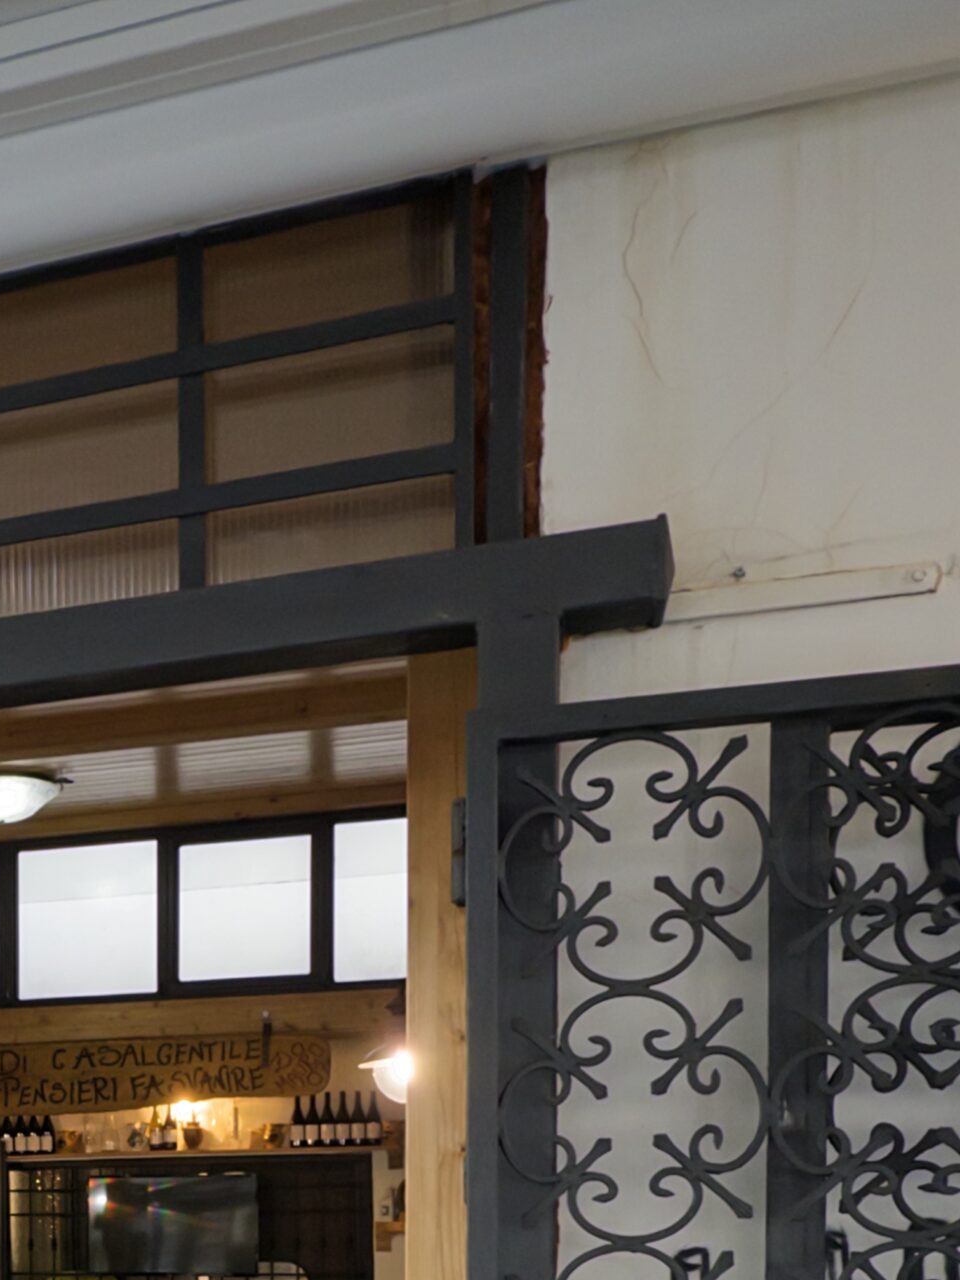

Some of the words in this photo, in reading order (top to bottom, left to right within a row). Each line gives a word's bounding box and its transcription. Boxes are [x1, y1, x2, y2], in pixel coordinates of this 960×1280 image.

[52, 1039, 262, 1070] CASALGENTILE
[130, 1072, 166, 1101] FA
[166, 1063, 266, 1094] SVANIRE
